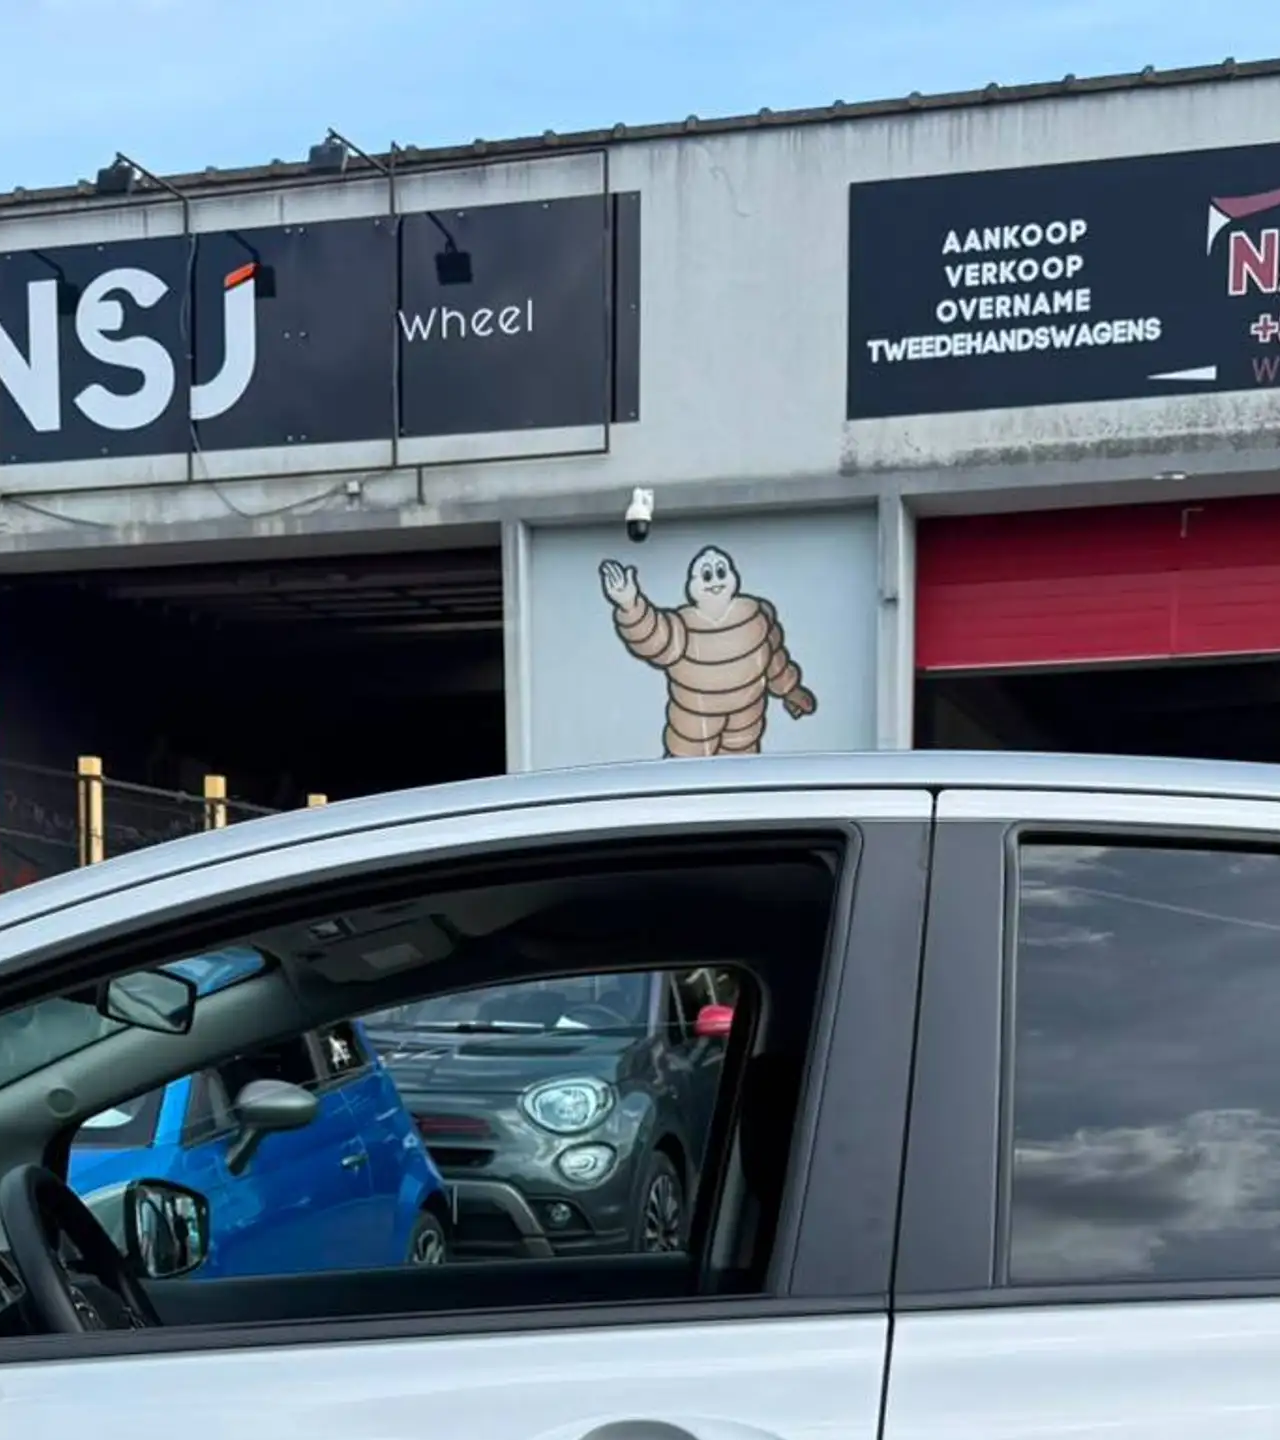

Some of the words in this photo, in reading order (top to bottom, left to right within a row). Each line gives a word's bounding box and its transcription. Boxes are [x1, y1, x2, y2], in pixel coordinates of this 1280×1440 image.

[942, 219, 1087, 255] AANKOOP
[944, 255, 1084, 288] VERKOOP
[935, 288, 1091, 323] OVERNAME
[867, 317, 1162, 363] TWEEDEHANDSWAGENS
